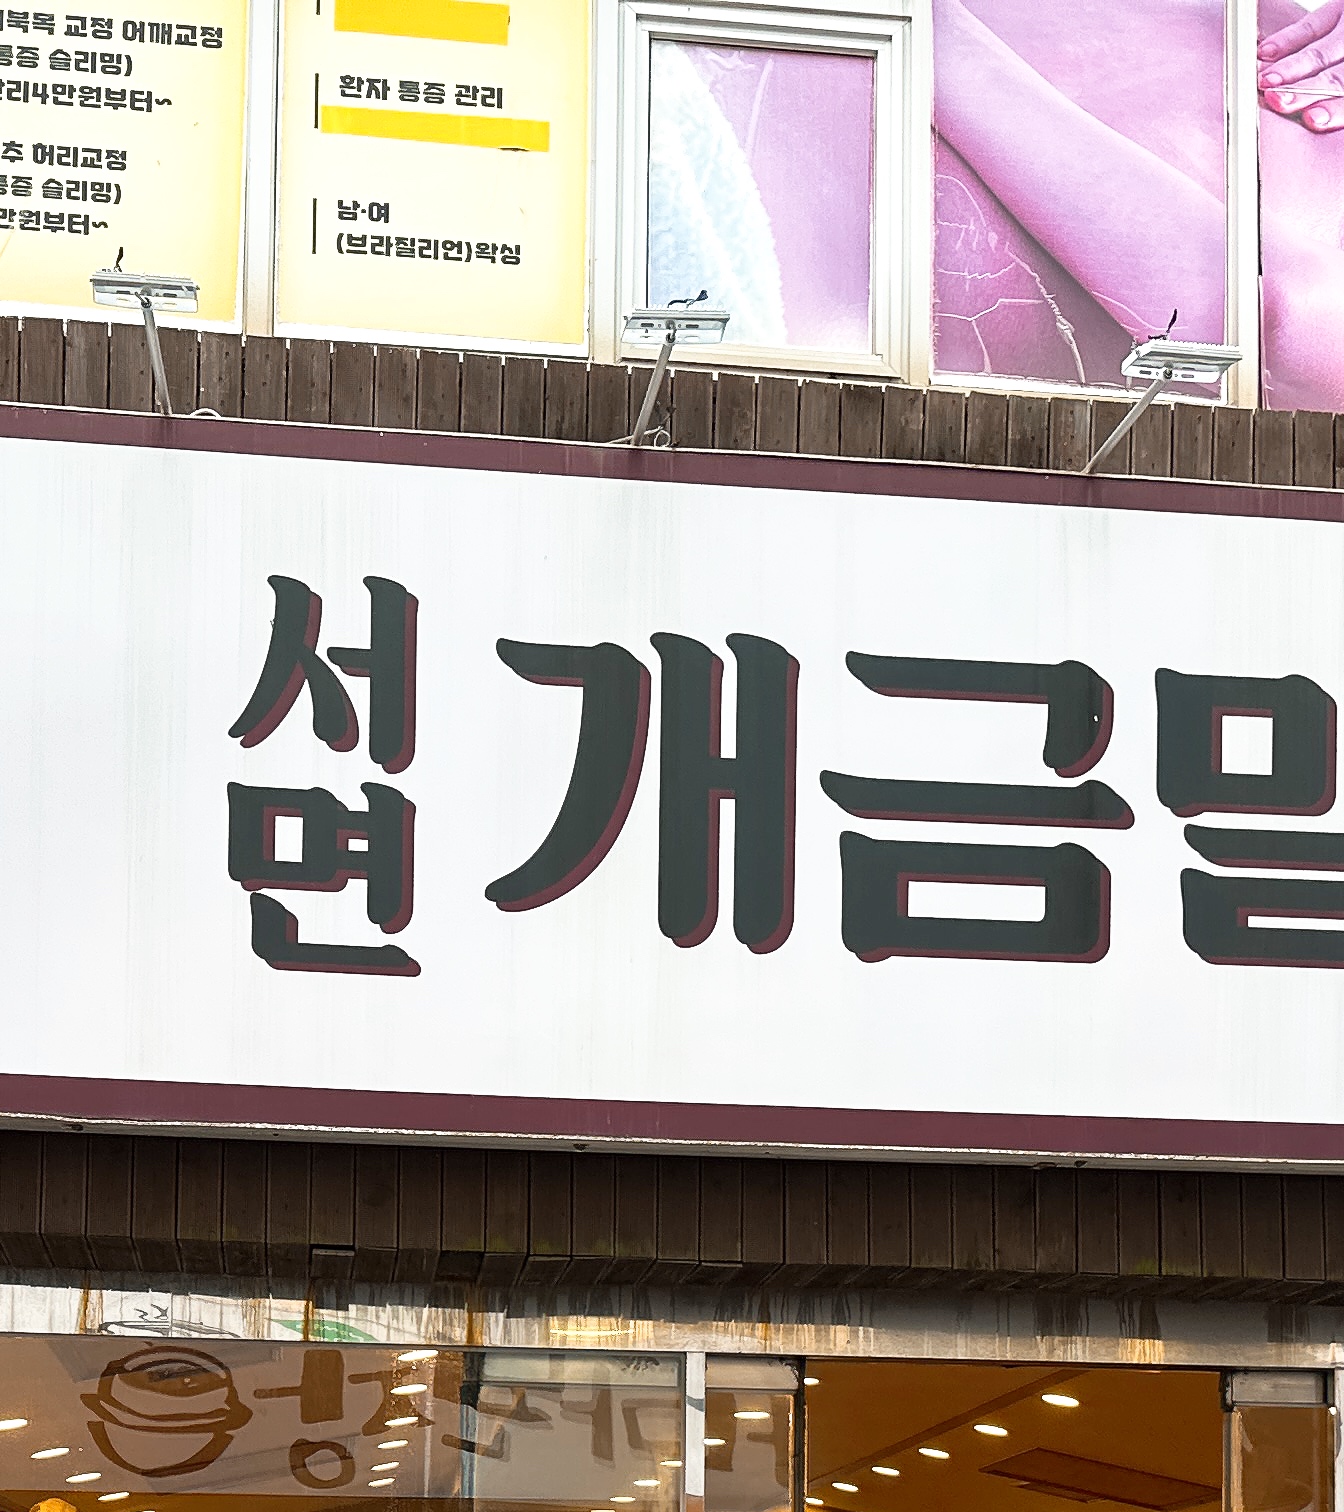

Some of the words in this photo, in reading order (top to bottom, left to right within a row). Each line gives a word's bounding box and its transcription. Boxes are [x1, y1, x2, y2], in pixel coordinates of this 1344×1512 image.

[64, 15, 113, 40] 교정
[122, 20, 223, 49] 어깨교정
[49, 49, 133, 76] 슬리밍)
[339, 74, 390, 101] 환자
[398, 79, 446, 105] 통증
[455, 83, 503, 109] 관리
[32, 142, 127, 171] 허리교정
[41, 178, 122, 204] 슬리밍)
[227, 573, 421, 978] 서면
